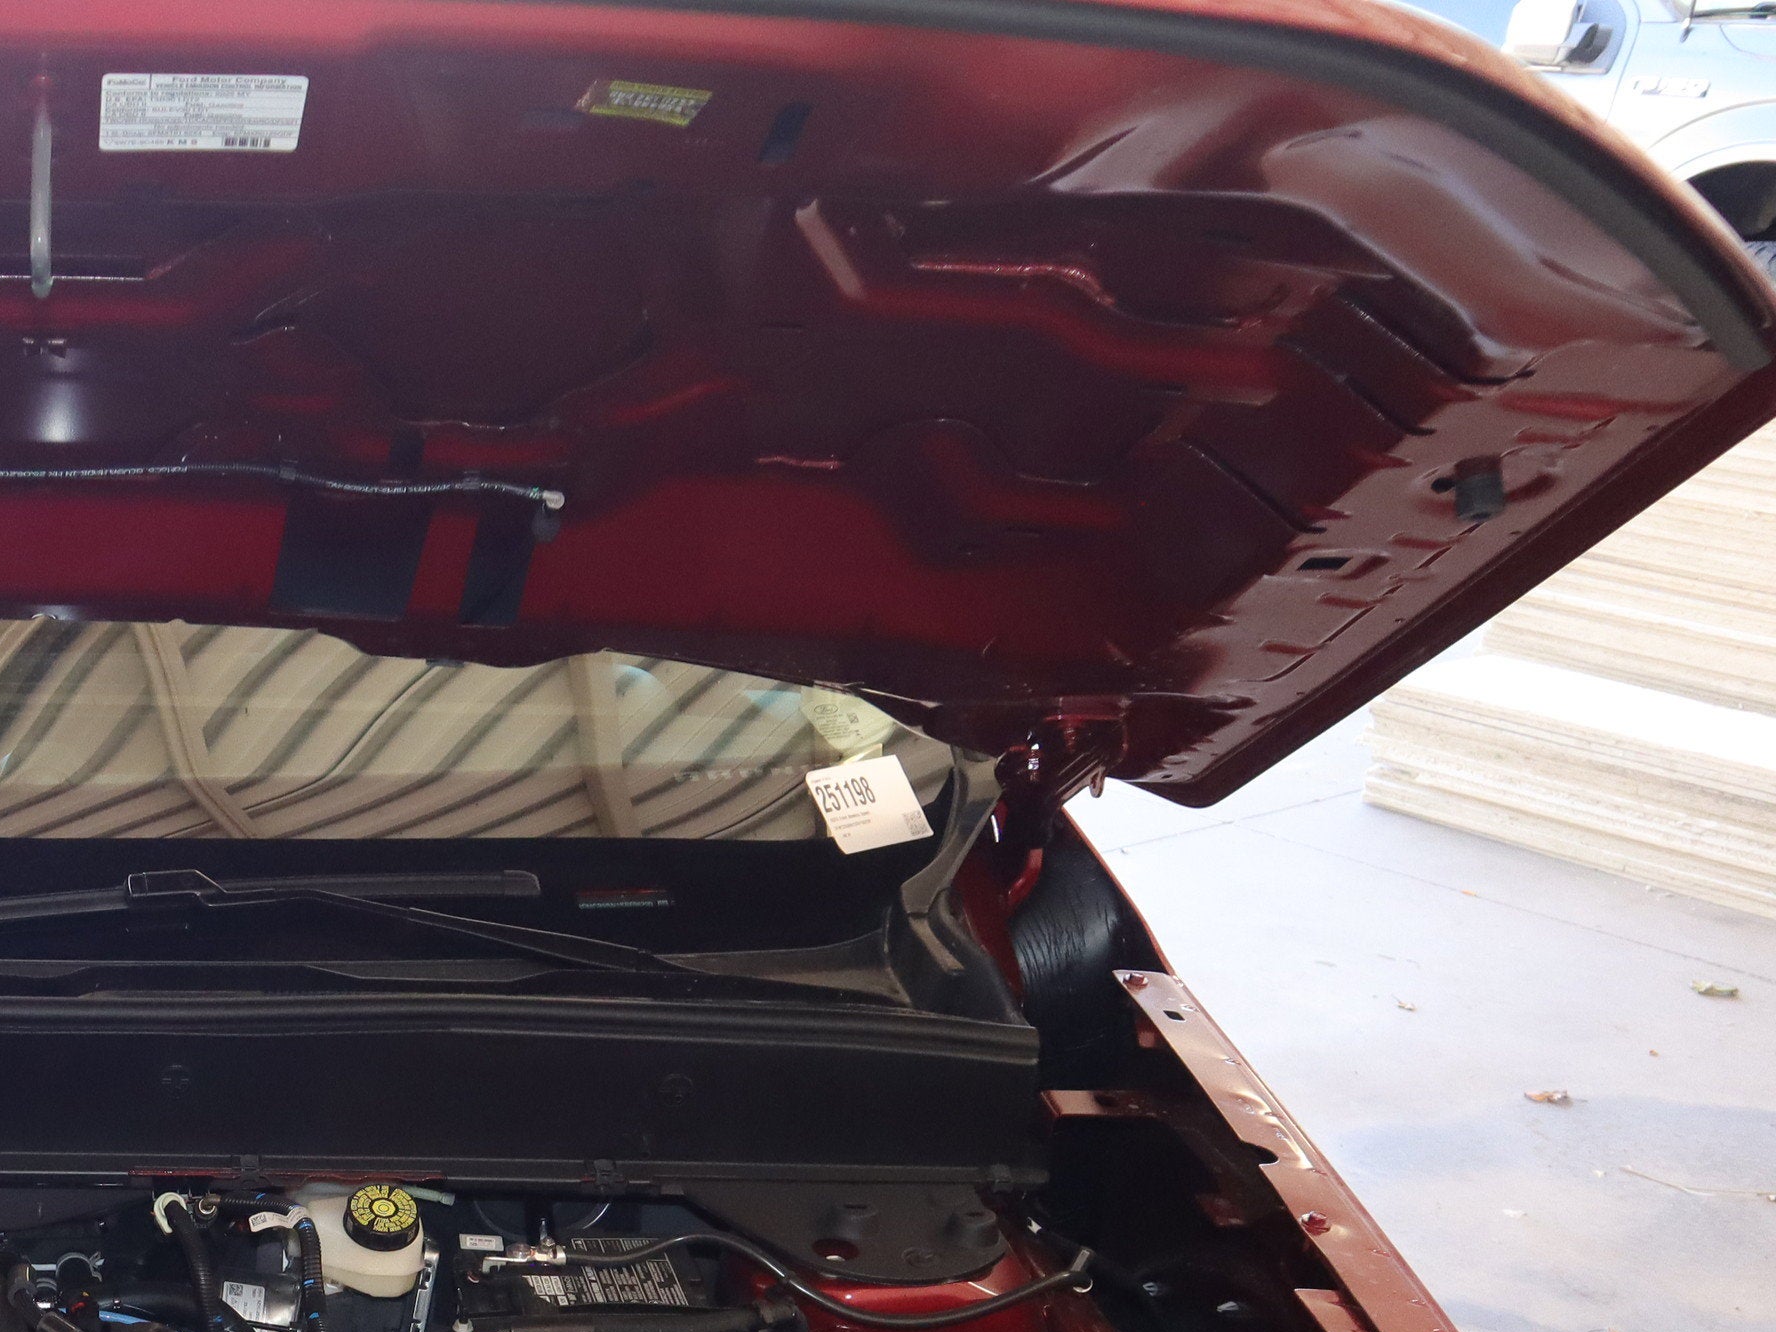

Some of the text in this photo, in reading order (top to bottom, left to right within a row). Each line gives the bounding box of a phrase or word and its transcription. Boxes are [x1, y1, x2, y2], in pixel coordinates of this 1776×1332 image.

[200, 76, 232, 84] Motor
[236, 77, 287, 86] Company
[815, 776, 876, 813] 251198
